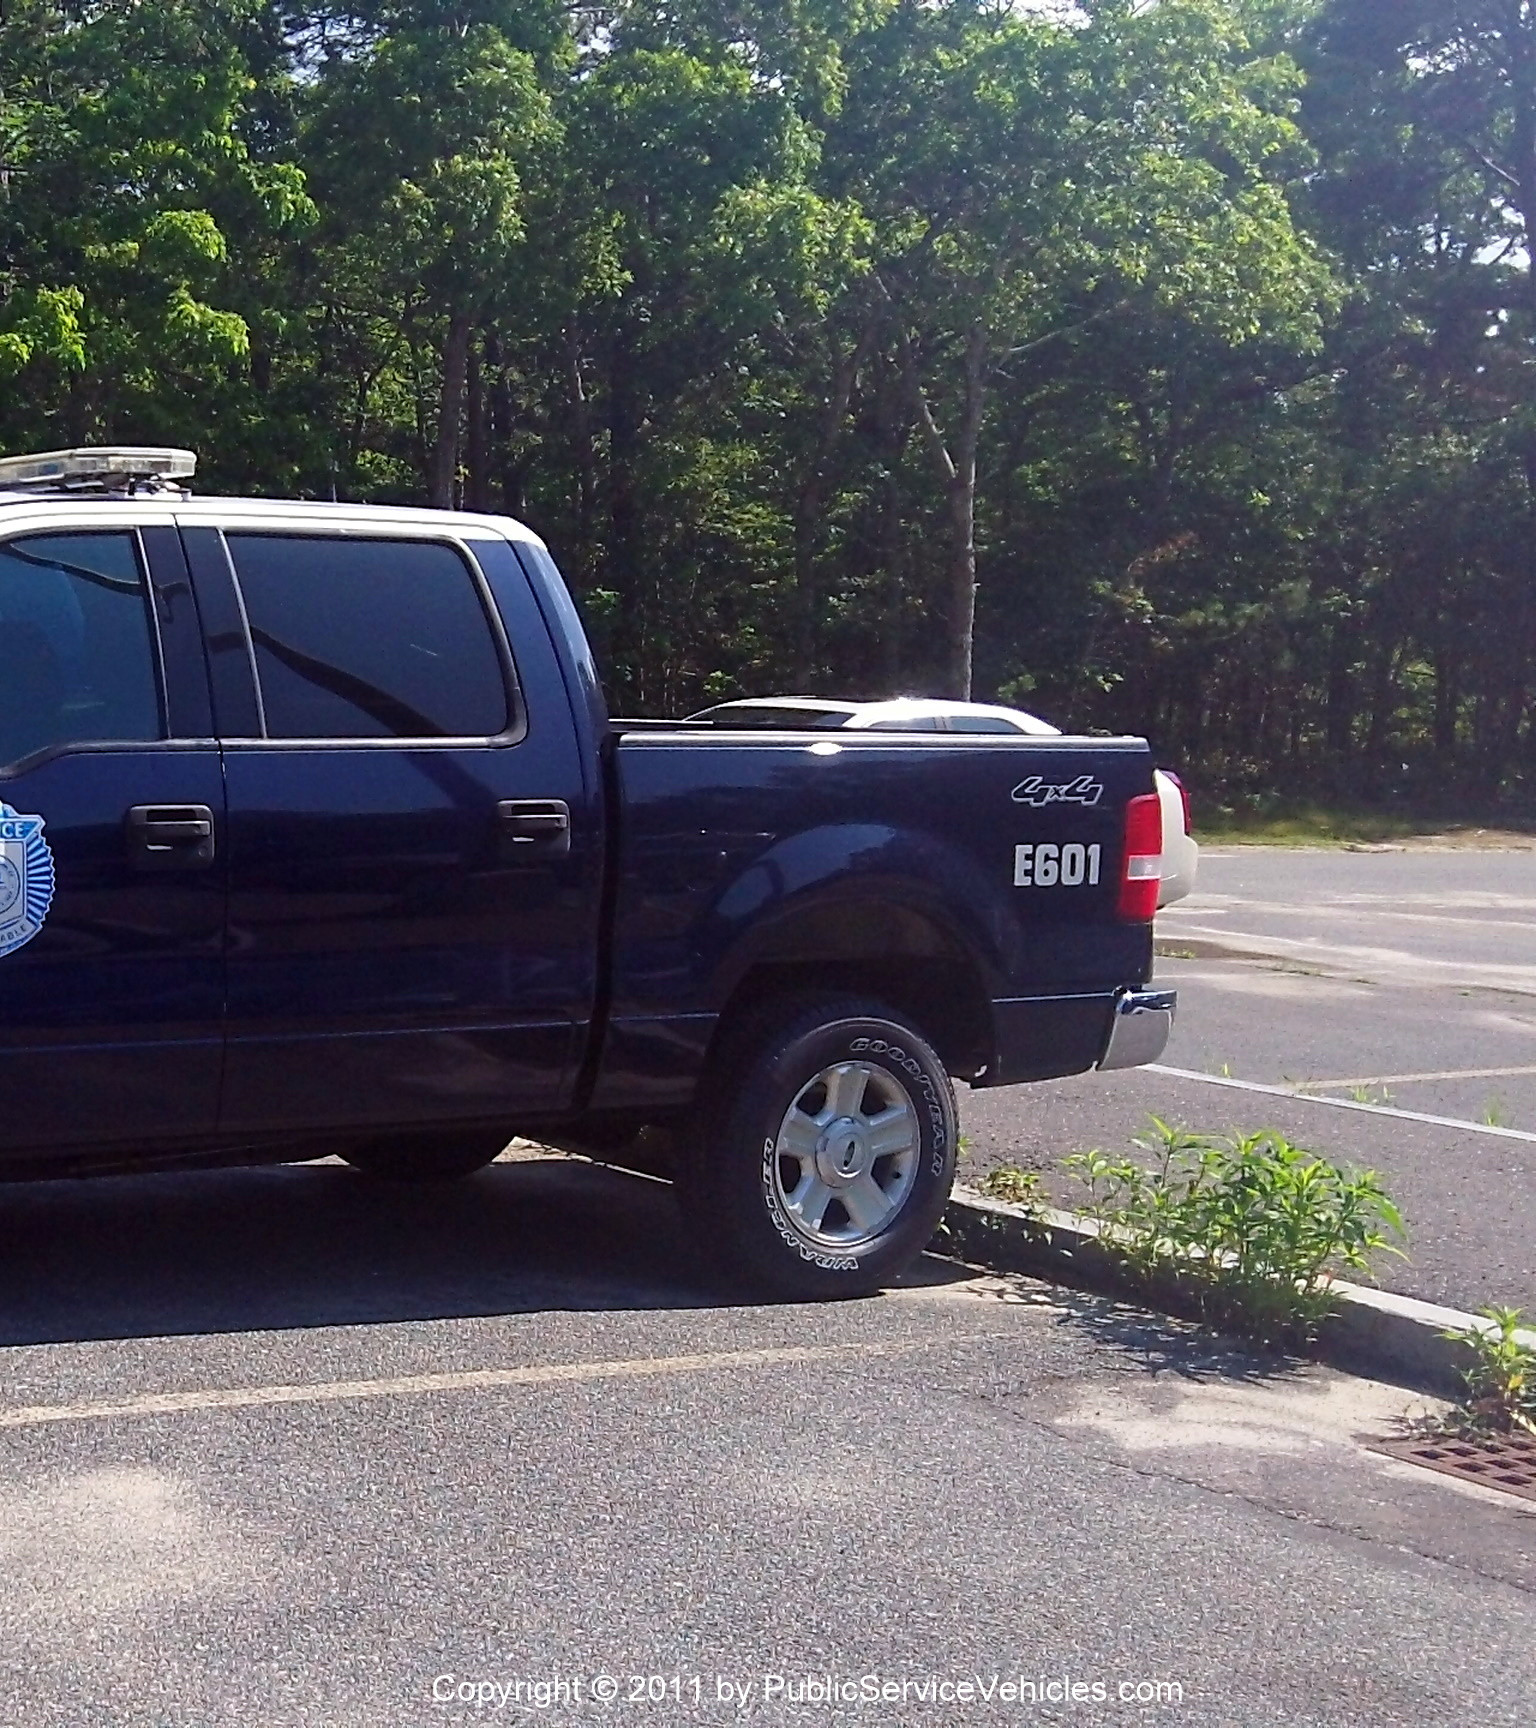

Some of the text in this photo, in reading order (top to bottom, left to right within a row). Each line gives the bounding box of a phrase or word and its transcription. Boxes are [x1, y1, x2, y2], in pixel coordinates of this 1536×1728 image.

[1011, 775, 1103, 807] 4x4
[1013, 843, 1101, 886] E601
[850, 1038, 946, 1176] GOODYEAR
